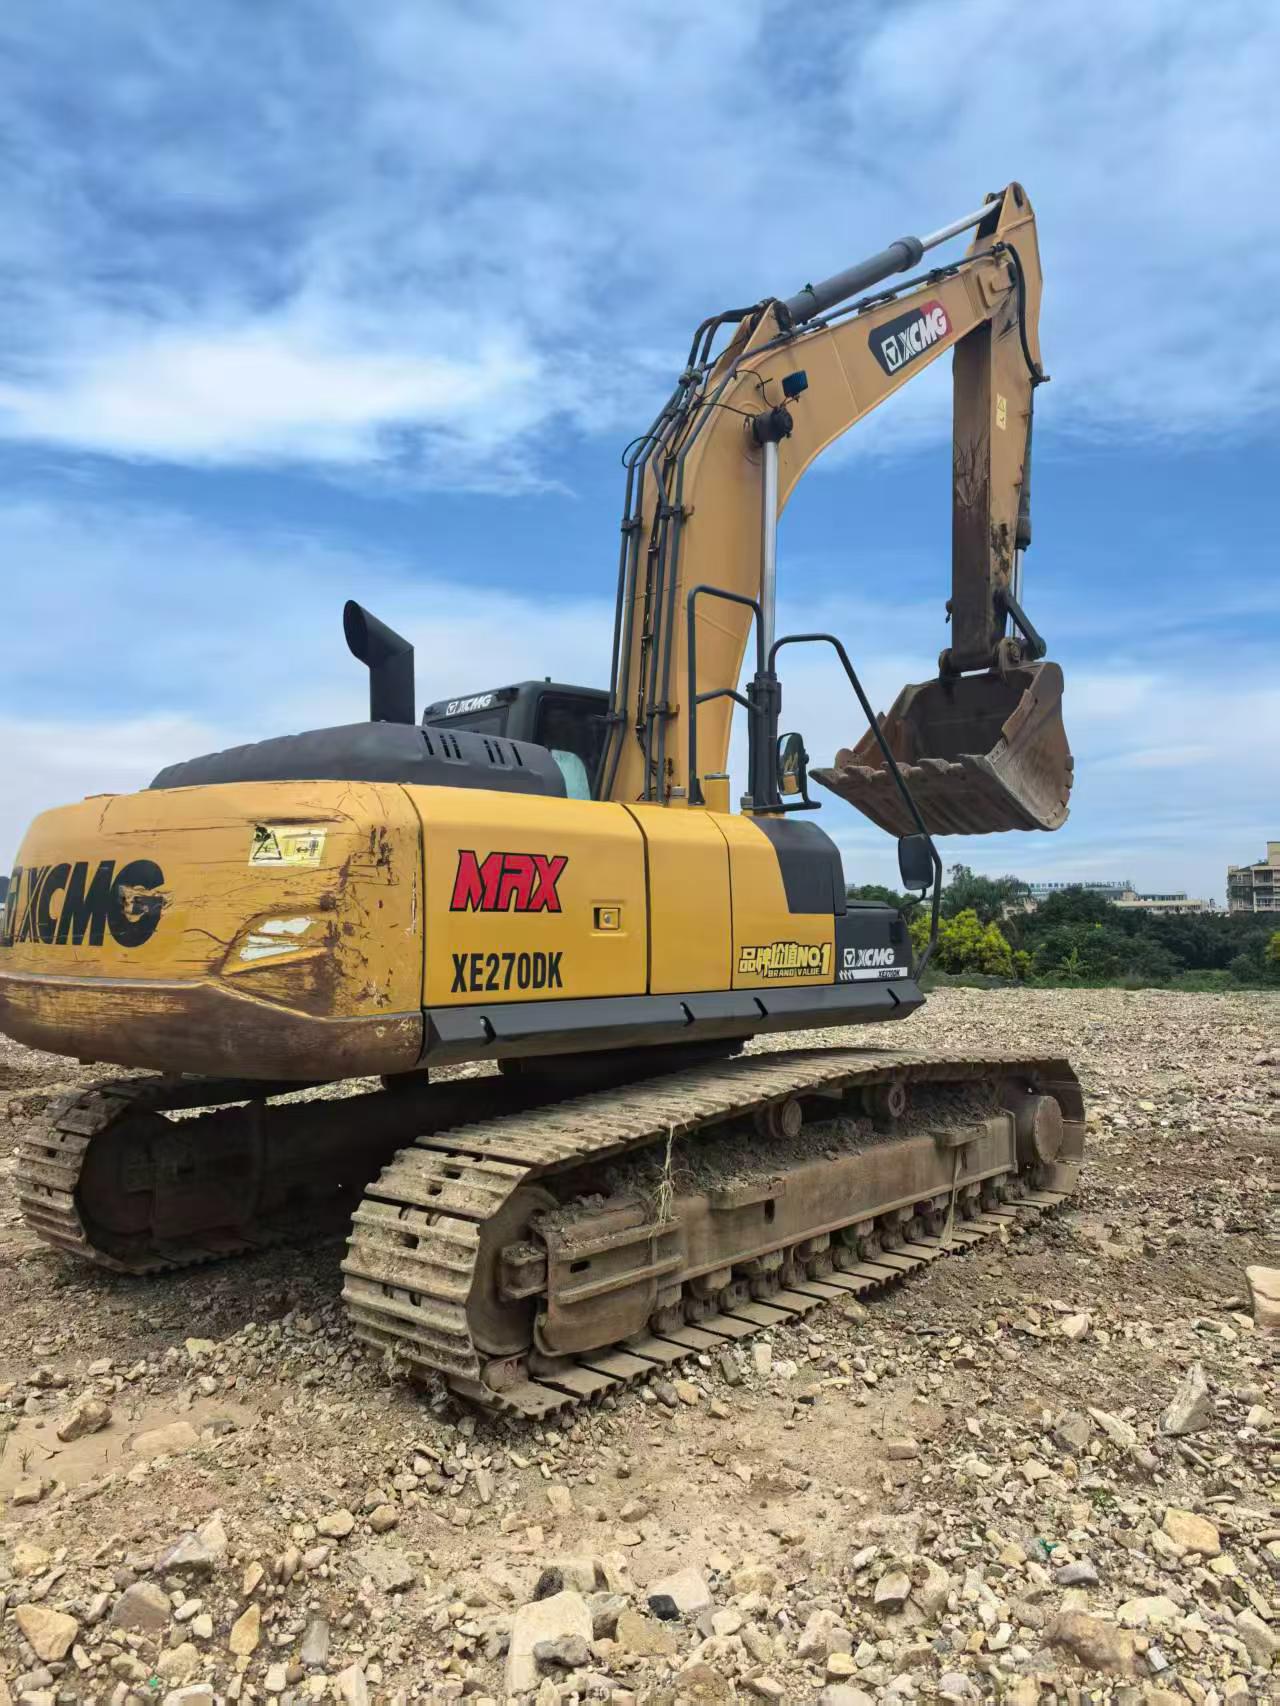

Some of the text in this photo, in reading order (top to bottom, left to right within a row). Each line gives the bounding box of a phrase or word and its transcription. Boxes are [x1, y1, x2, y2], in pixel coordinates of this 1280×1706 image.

[897, 308, 947, 361] XCMG
[457, 694, 492, 713] XCMG
[449, 850, 568, 913] MAX
[15, 859, 165, 947] XCMG
[450, 951, 563, 993] XE270DK
[767, 967, 820, 978] BRAND VALUE
[856, 948, 895, 967] XCMG
